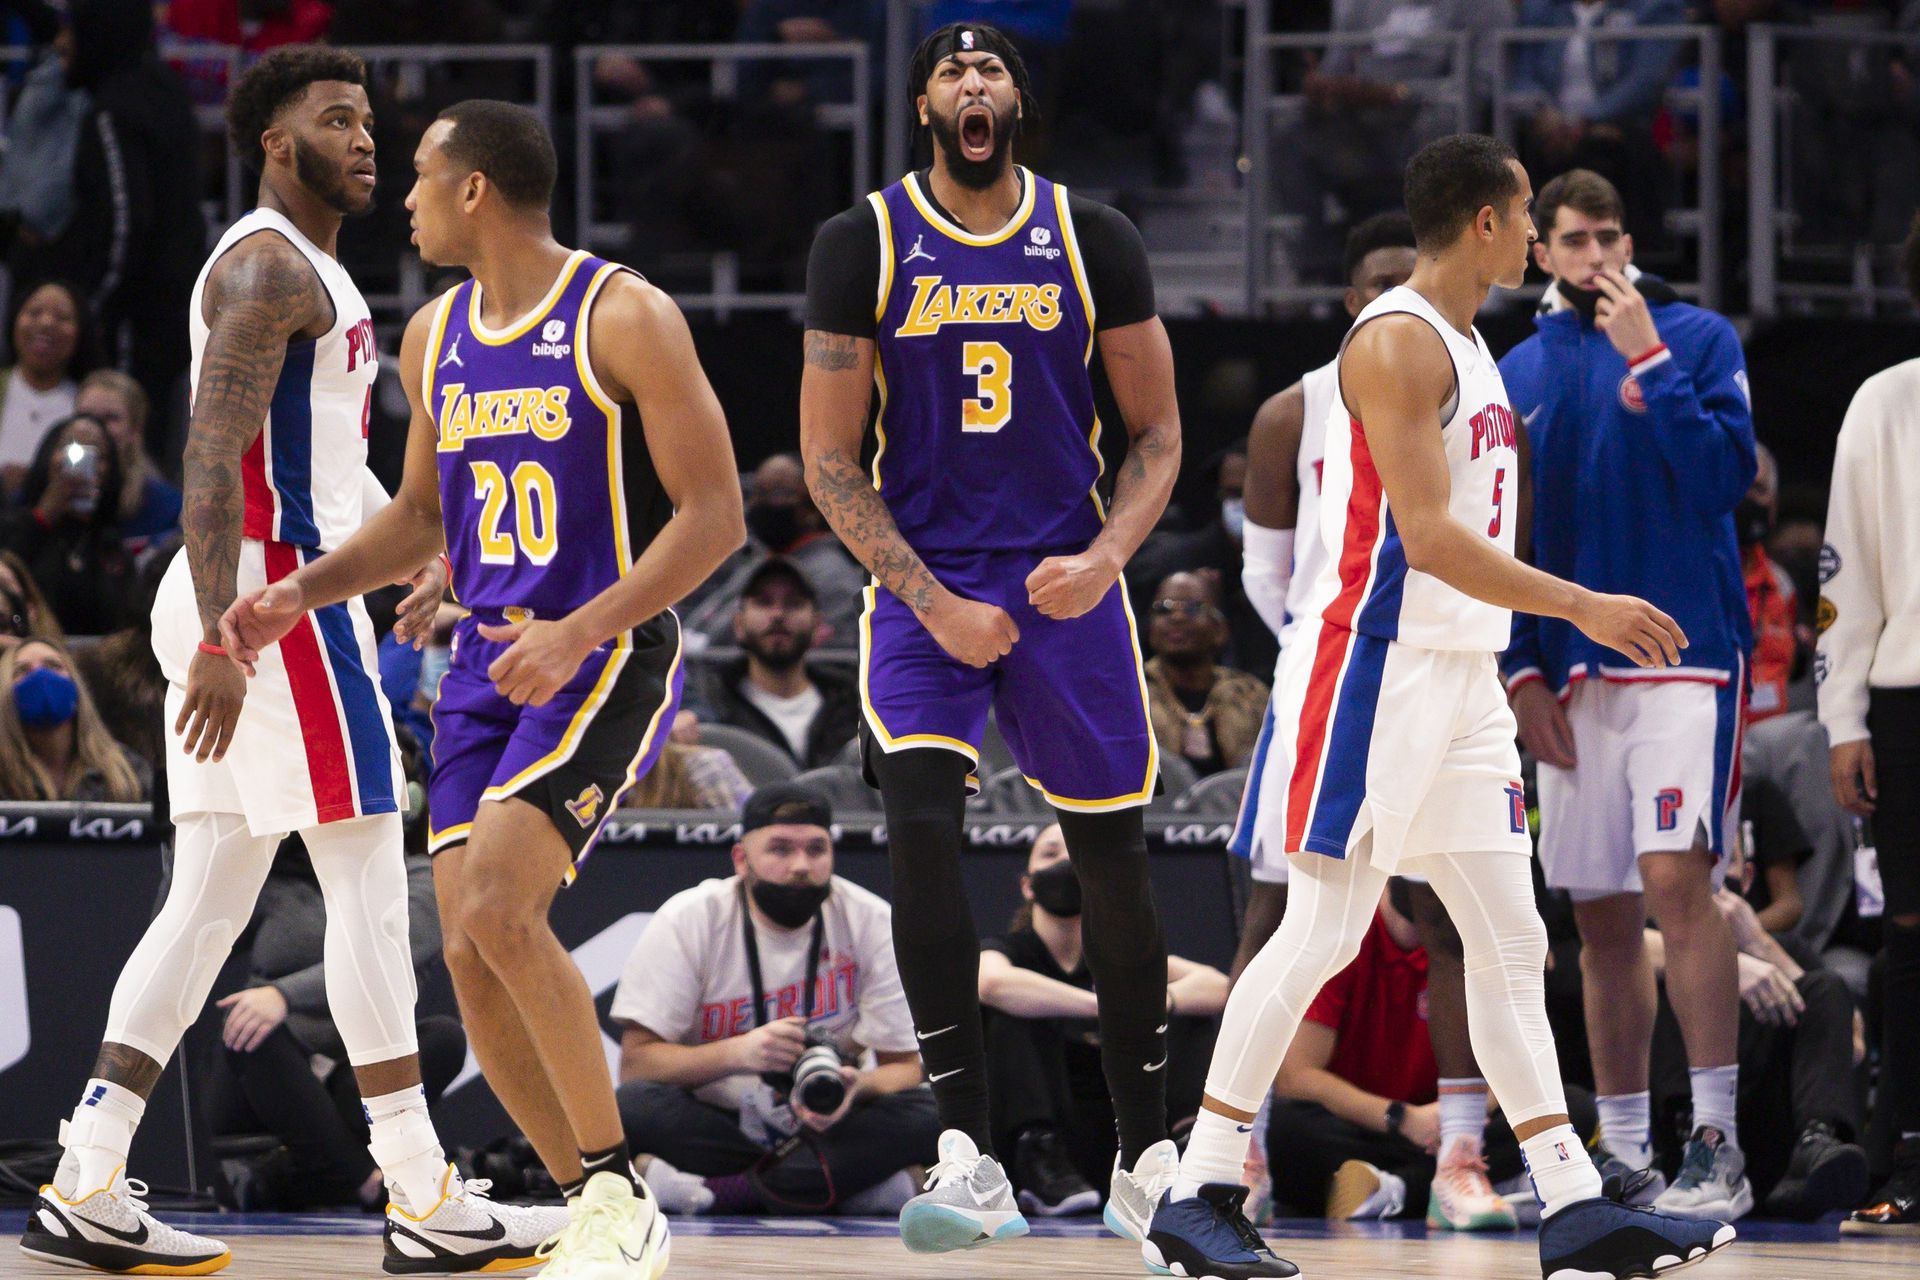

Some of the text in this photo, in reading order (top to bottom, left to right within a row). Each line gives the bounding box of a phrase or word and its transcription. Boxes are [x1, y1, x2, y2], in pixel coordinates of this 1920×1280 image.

[1024, 245, 1060, 260] bibigo
[895, 276, 1062, 337] LAKERS
[532, 343, 571, 359] bibigo
[437, 383, 571, 452] LAKERS
[961, 341, 1012, 433] 3
[1468, 402, 1517, 461] PISTON
[468, 461, 558, 566] 20
[1487, 468, 1506, 538] 5
[69, 816, 143, 839] KIA
